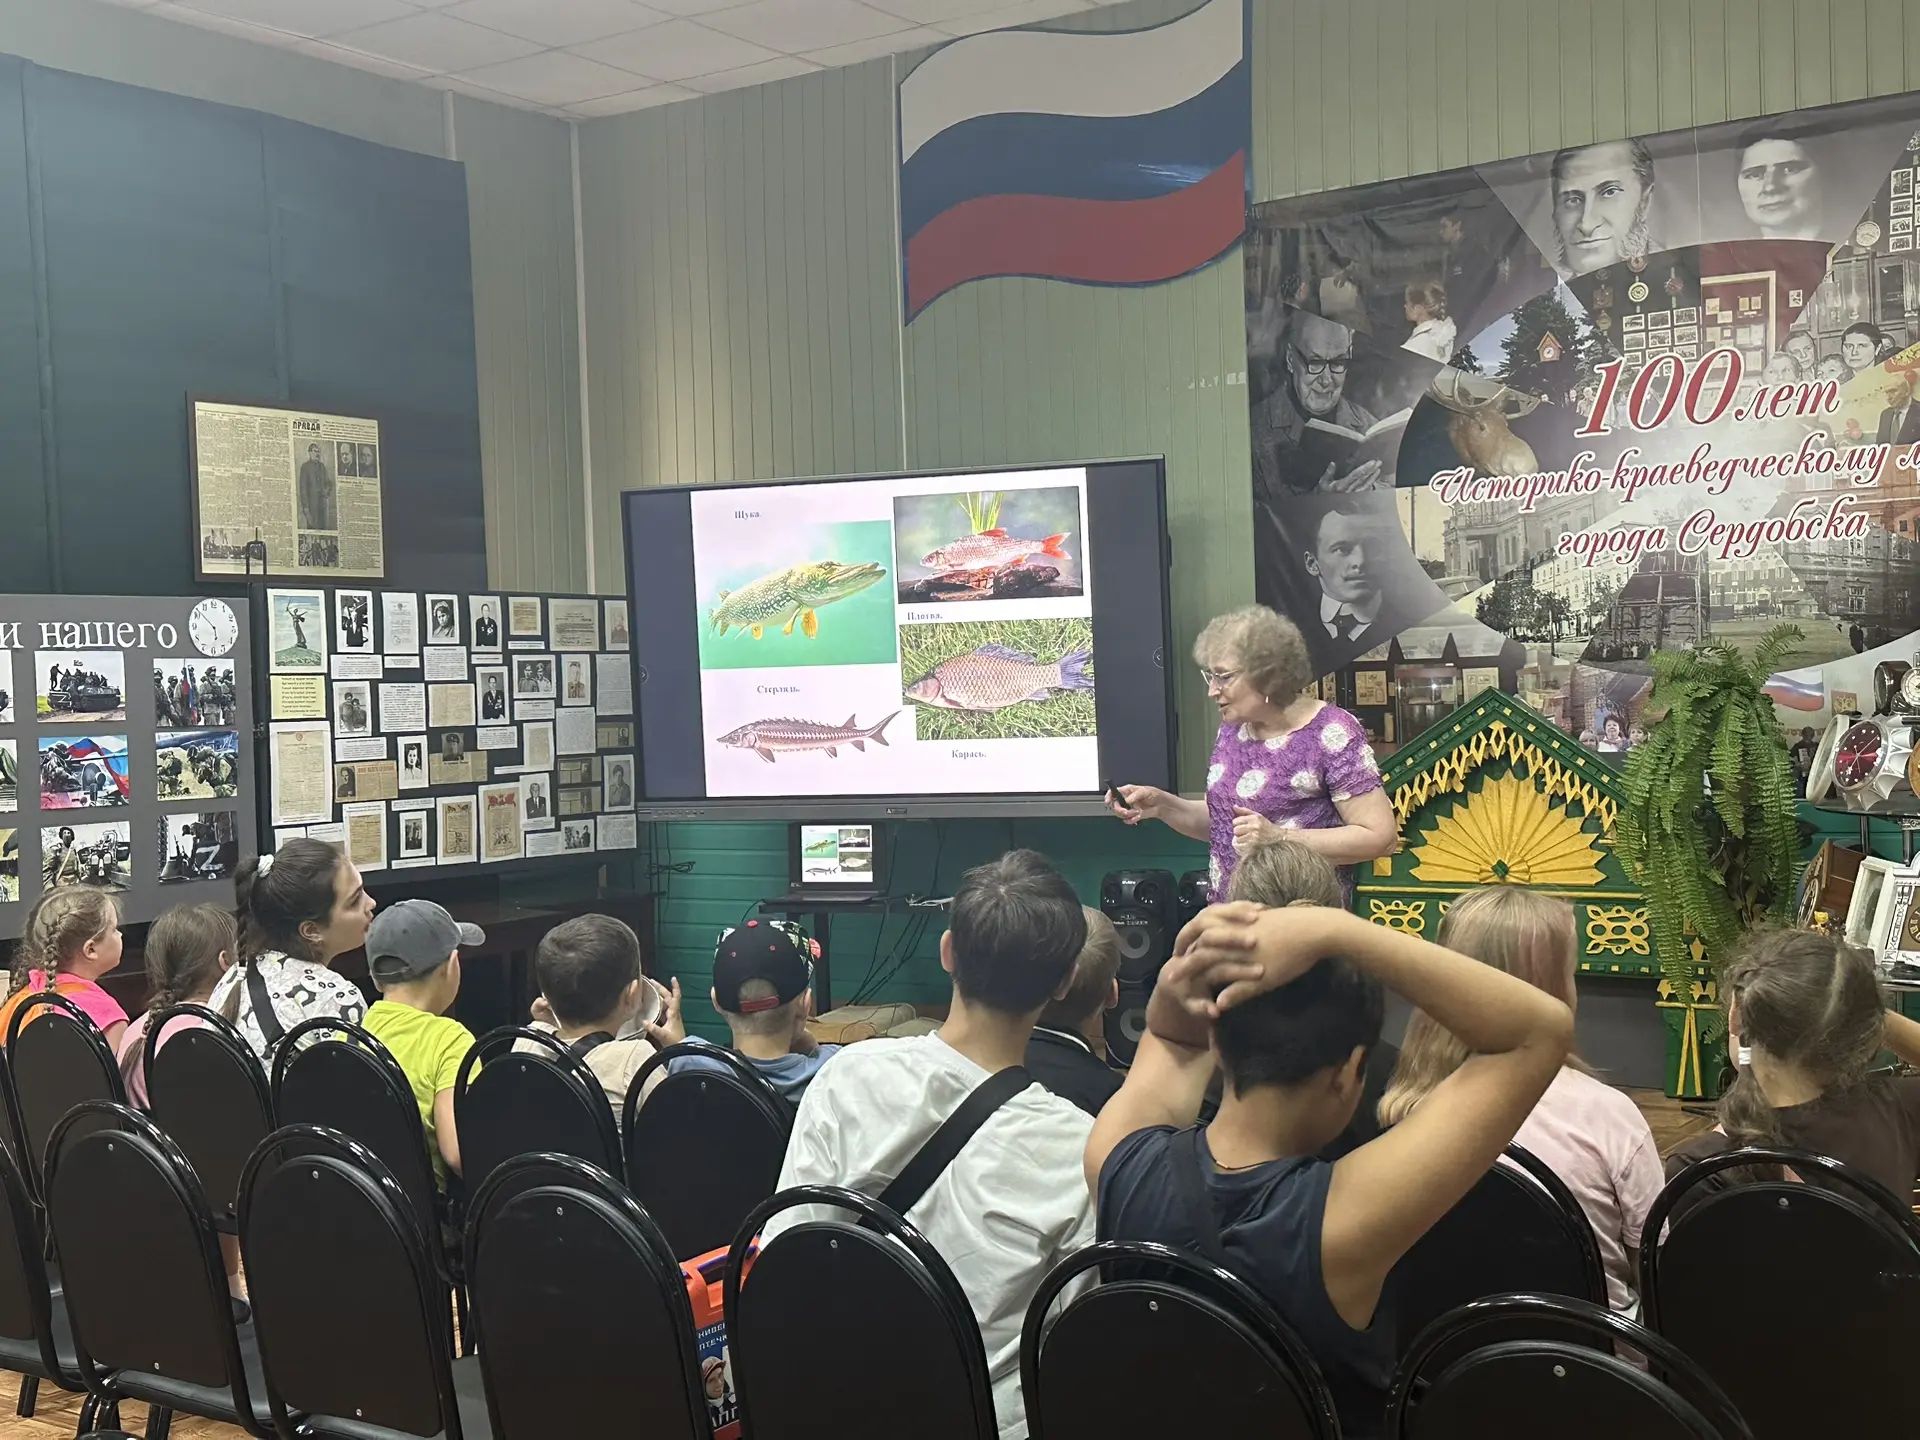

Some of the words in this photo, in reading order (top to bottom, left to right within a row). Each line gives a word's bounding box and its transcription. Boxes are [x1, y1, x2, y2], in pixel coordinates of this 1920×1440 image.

[1576, 349, 1742, 436] 100
[1734, 379, 1840, 421] лет
[1432, 433, 1888, 512] Историко-краеведческому
[1557, 528, 1667, 567] города
[1678, 495, 1868, 558] Сердобска
[38, 622, 177, 649] нашего
